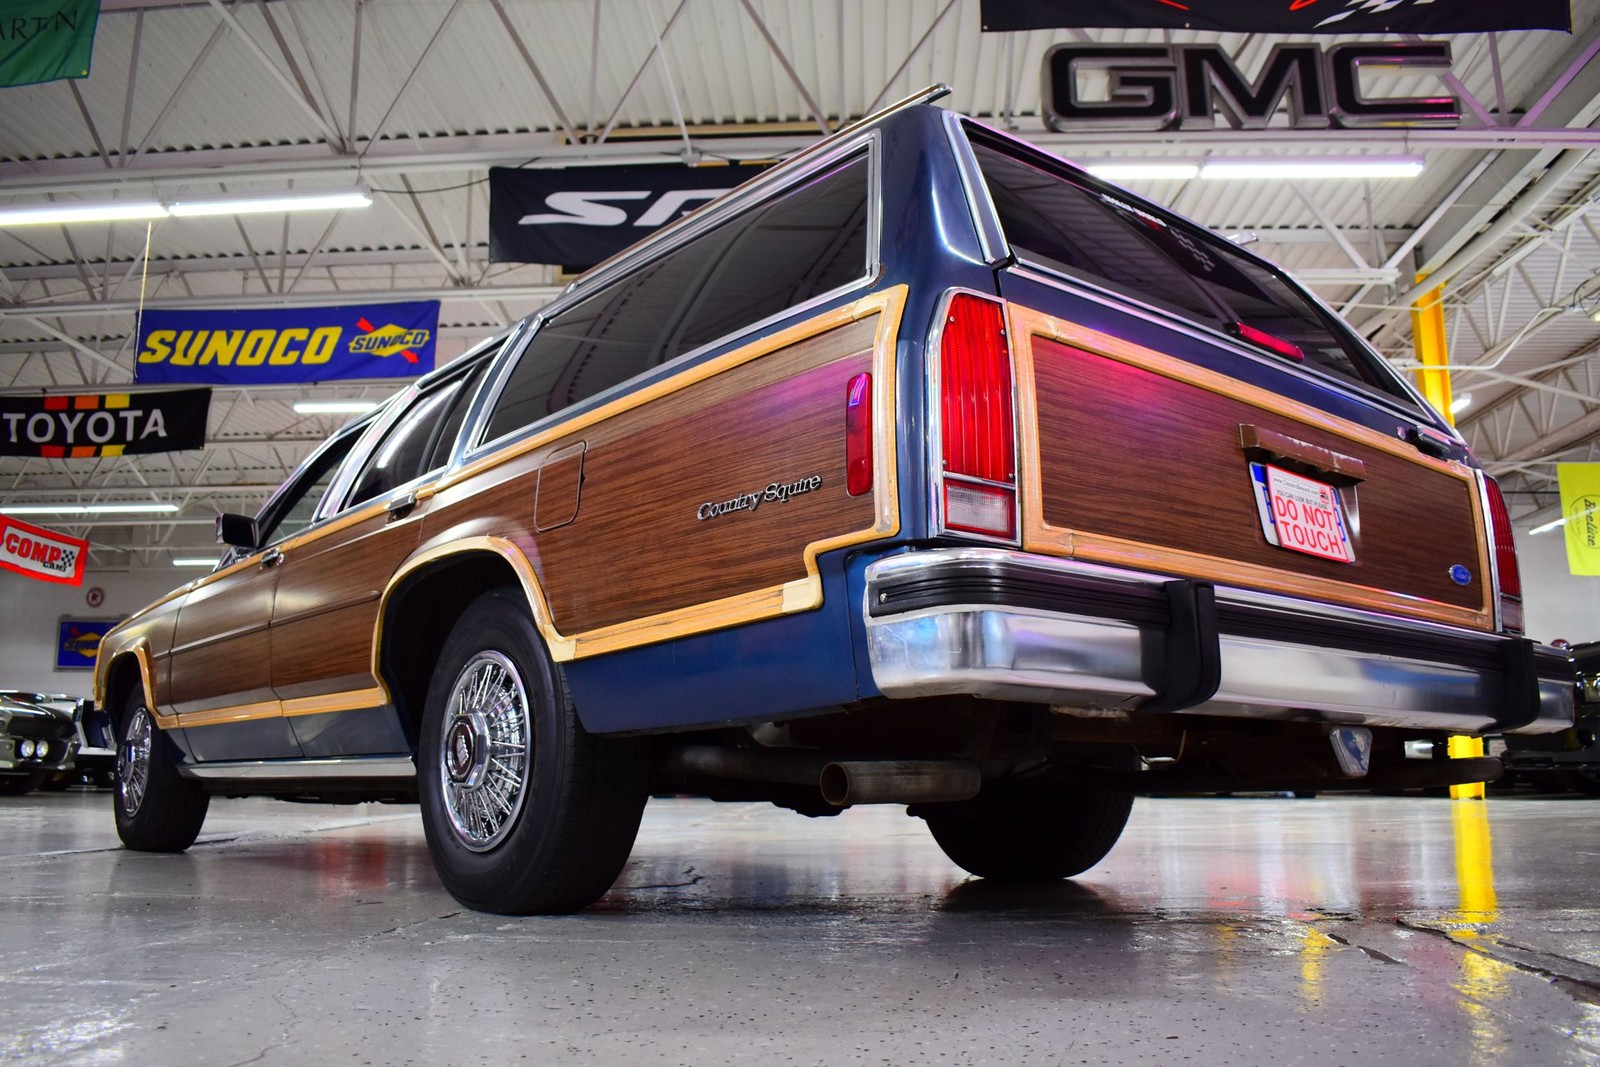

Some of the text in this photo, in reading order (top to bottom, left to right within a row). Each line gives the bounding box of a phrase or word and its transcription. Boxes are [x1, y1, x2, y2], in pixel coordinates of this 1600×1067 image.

[1042, 42, 1462, 132] GMC
[138, 326, 427, 366] SUNOCO SUNOCO
[2, 409, 168, 444] TOYOTA
[697, 475, 822, 520] Country Squire
[1275, 495, 1332, 531] DO NOT
[6, 533, 61, 563] COMP
[1280, 521, 1342, 555] TOUCH
[43, 561, 67, 572] CAMS
